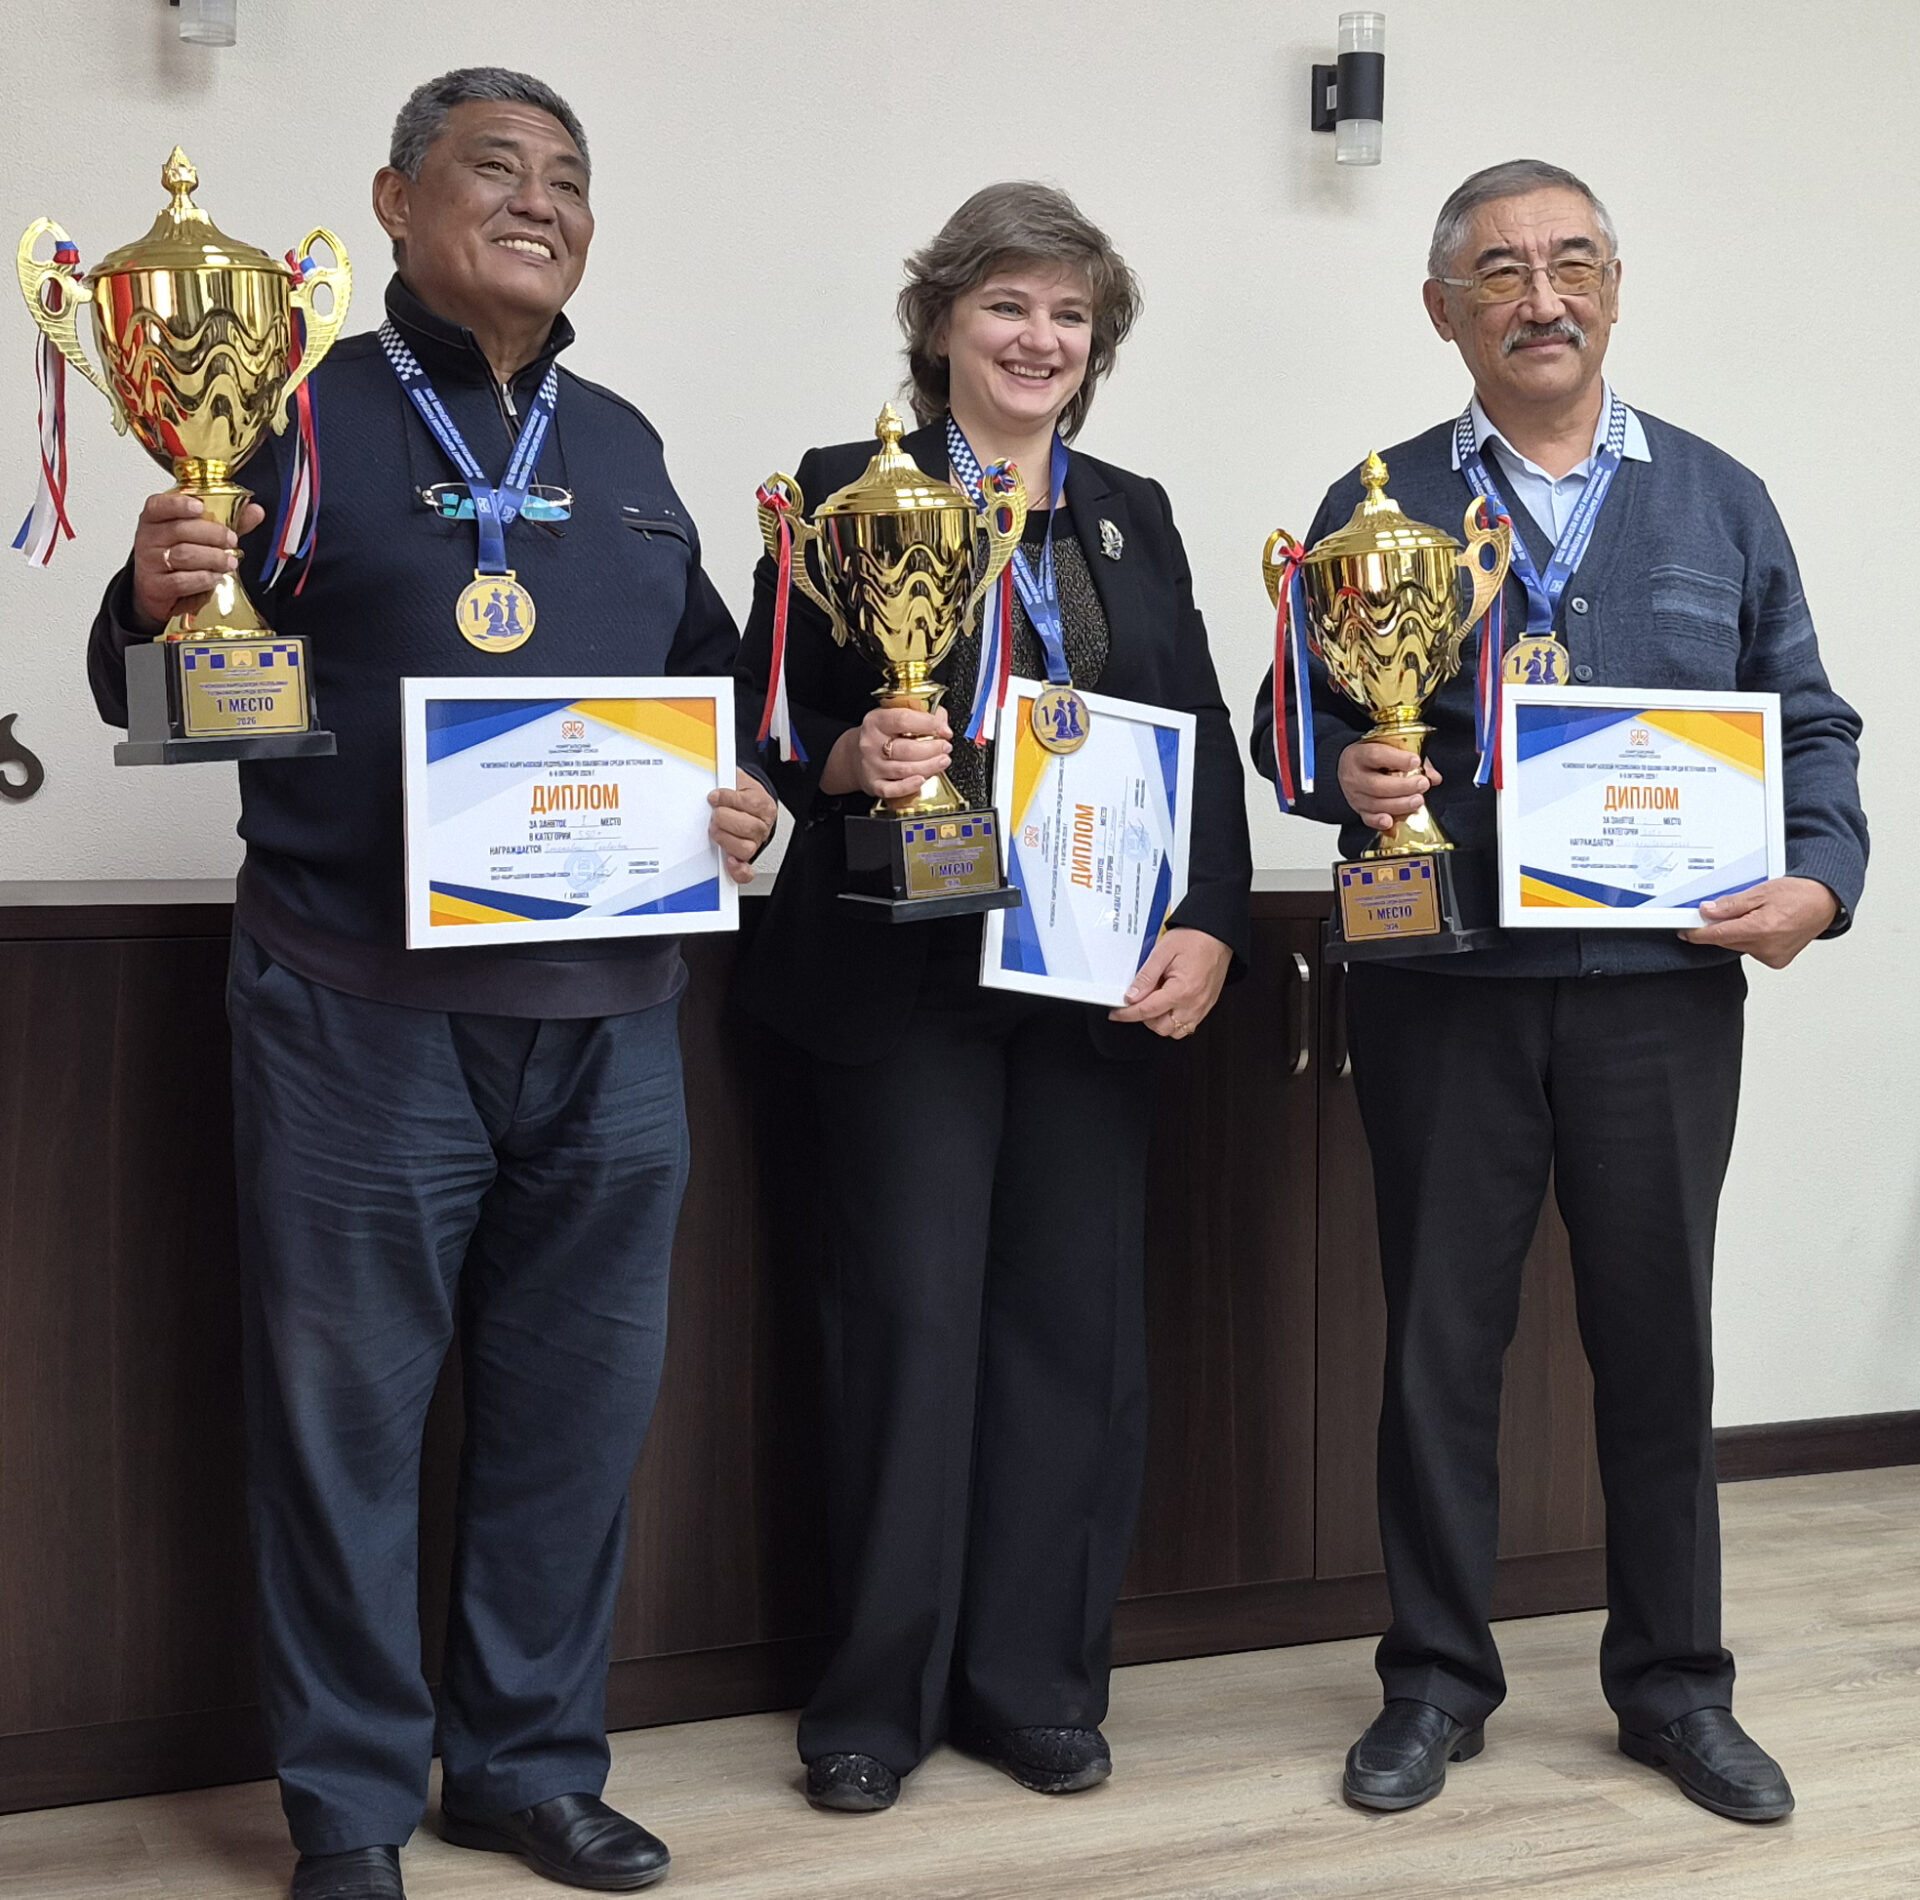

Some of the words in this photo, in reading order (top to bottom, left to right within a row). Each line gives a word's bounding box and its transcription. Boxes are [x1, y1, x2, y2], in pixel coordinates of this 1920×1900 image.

[470, 598, 479, 621] 1
[1513, 655, 1521, 675] 1
[216, 699, 223, 713] 1
[229, 697, 274, 712] МЕСТО
[1041, 705, 1050, 726] 1
[531, 783, 619, 814] ДИПЛОМ
[1604, 786, 1679, 812] ДИПЛОМ
[529, 820, 537, 829] ЗА
[600, 817, 622, 826] МЕСТО
[529, 832, 534, 841] В
[535, 831, 572, 841] КАТЕГОРИИ
[1070, 803, 1094, 889] ДИПЛОМ
[489, 845, 542, 856] НАГРАЖДАЕТСЯ
[1376, 905, 1412, 920] МЕСТО
